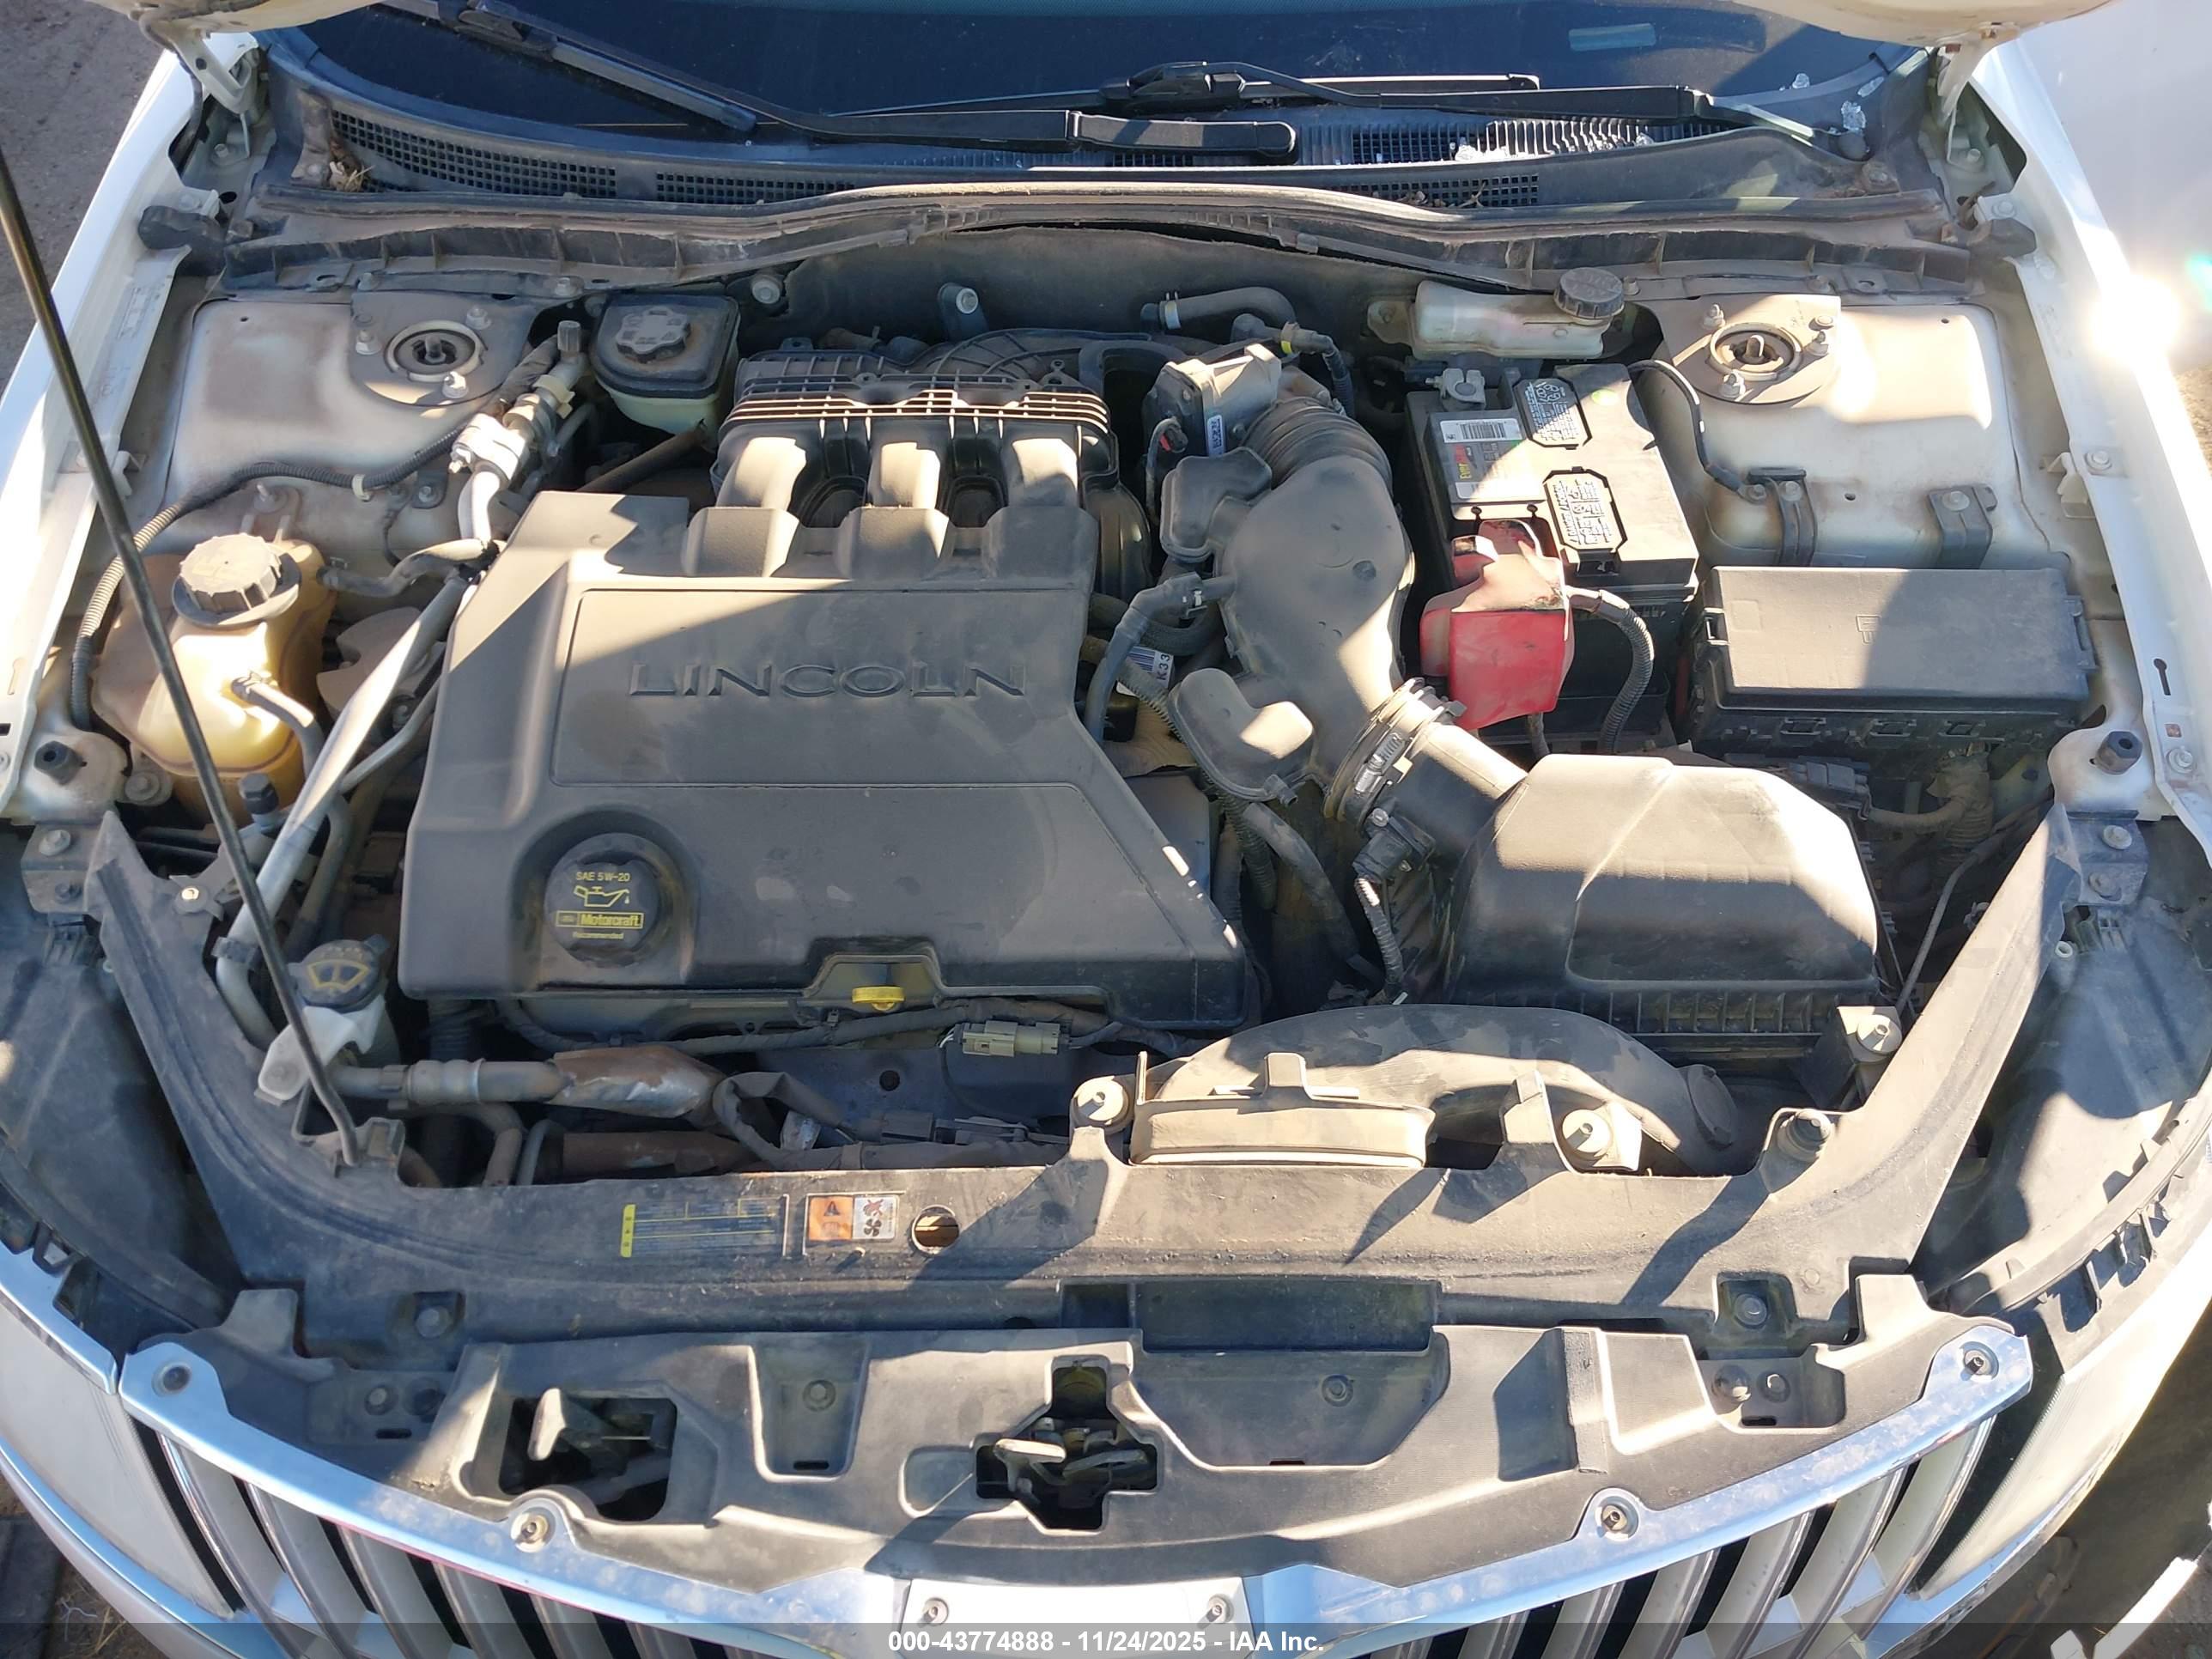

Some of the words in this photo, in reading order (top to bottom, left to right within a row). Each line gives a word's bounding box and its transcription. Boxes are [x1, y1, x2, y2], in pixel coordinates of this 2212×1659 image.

[1156, 653, 1170, 681] K33
[628, 660, 1026, 698] LINCOLN
[576, 872, 595, 881] SAE
[597, 872, 631, 882] 5W-20
[580, 913, 640, 927] Motorcraft
